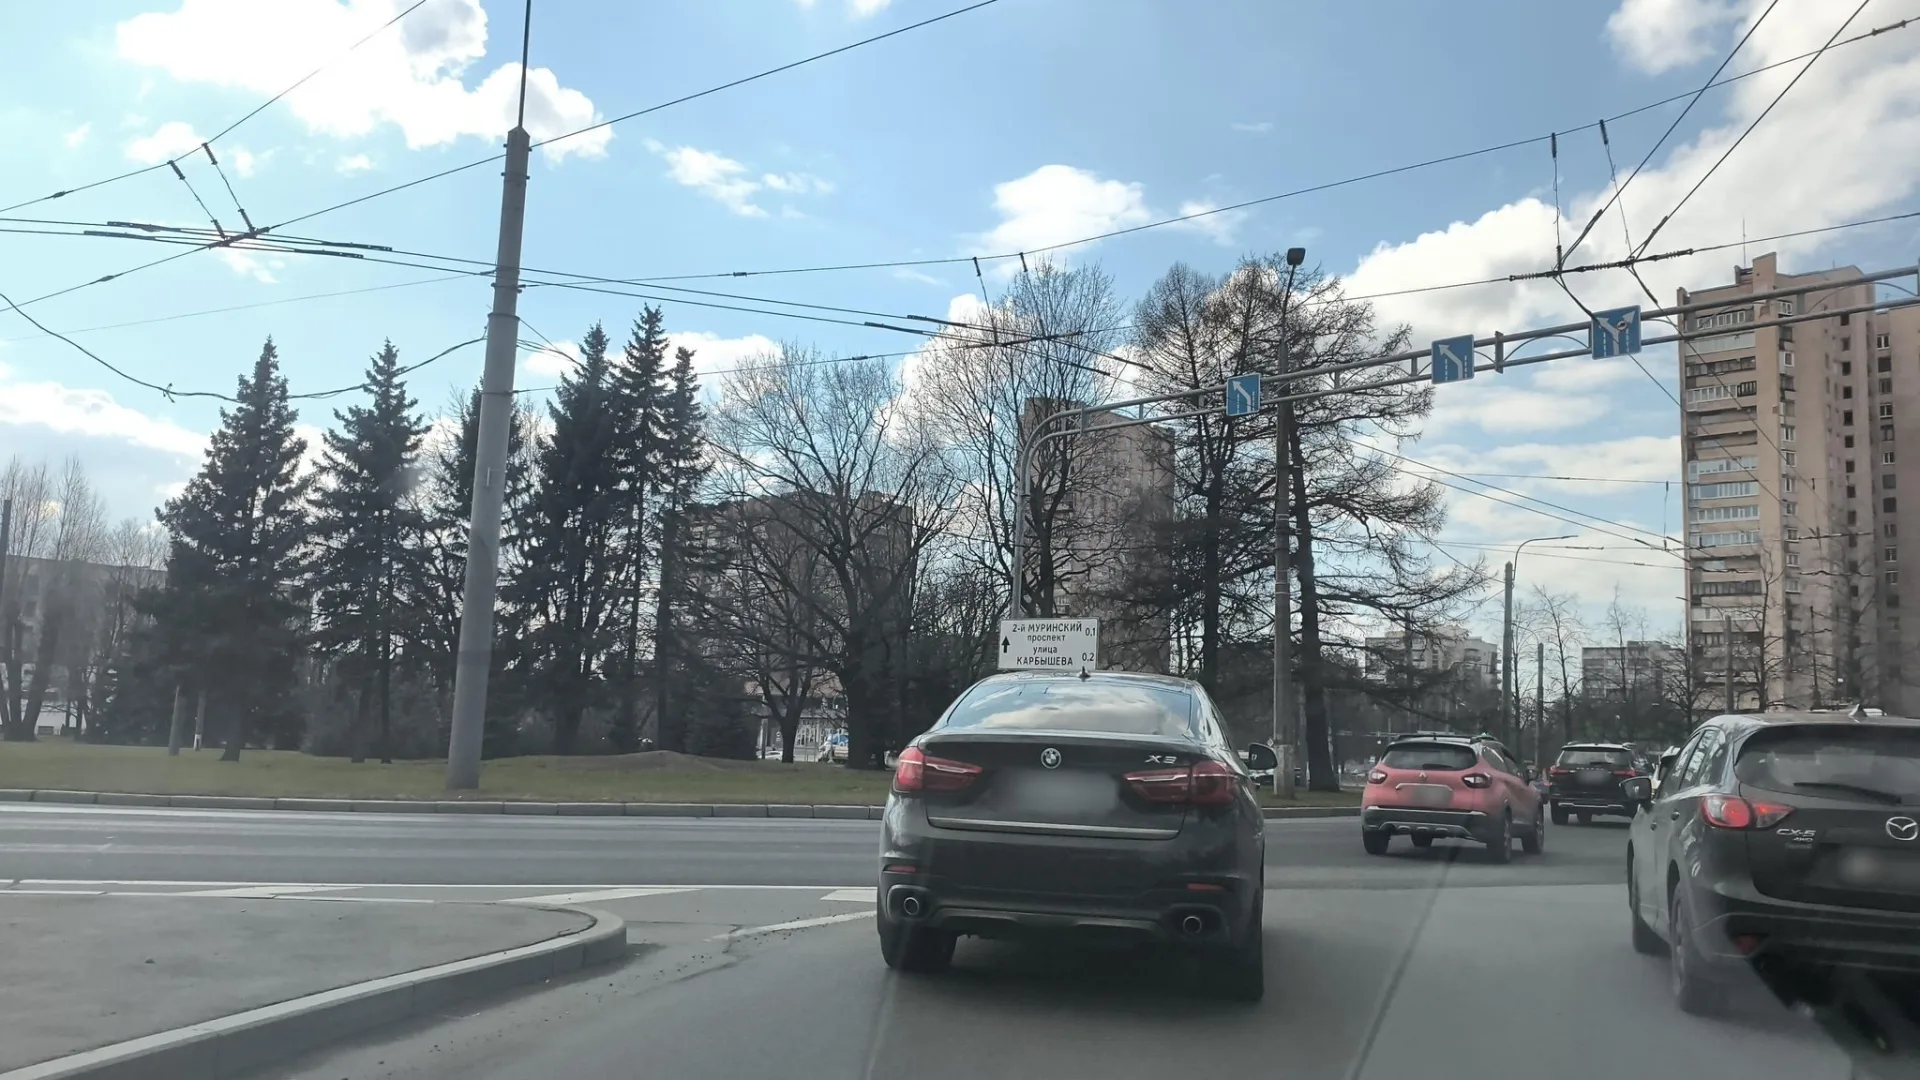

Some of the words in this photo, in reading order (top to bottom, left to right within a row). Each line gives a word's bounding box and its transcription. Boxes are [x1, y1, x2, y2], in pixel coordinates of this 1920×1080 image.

[1012, 624, 1026, 632] 2-й
[1027, 621, 1082, 632] МУРИНСКИЙ
[1027, 634, 1066, 643] проспект
[1033, 646, 1058, 655] улица
[1016, 656, 1073, 666] КАРБЫШЕВА
[1776, 828, 1817, 837] CX-5
